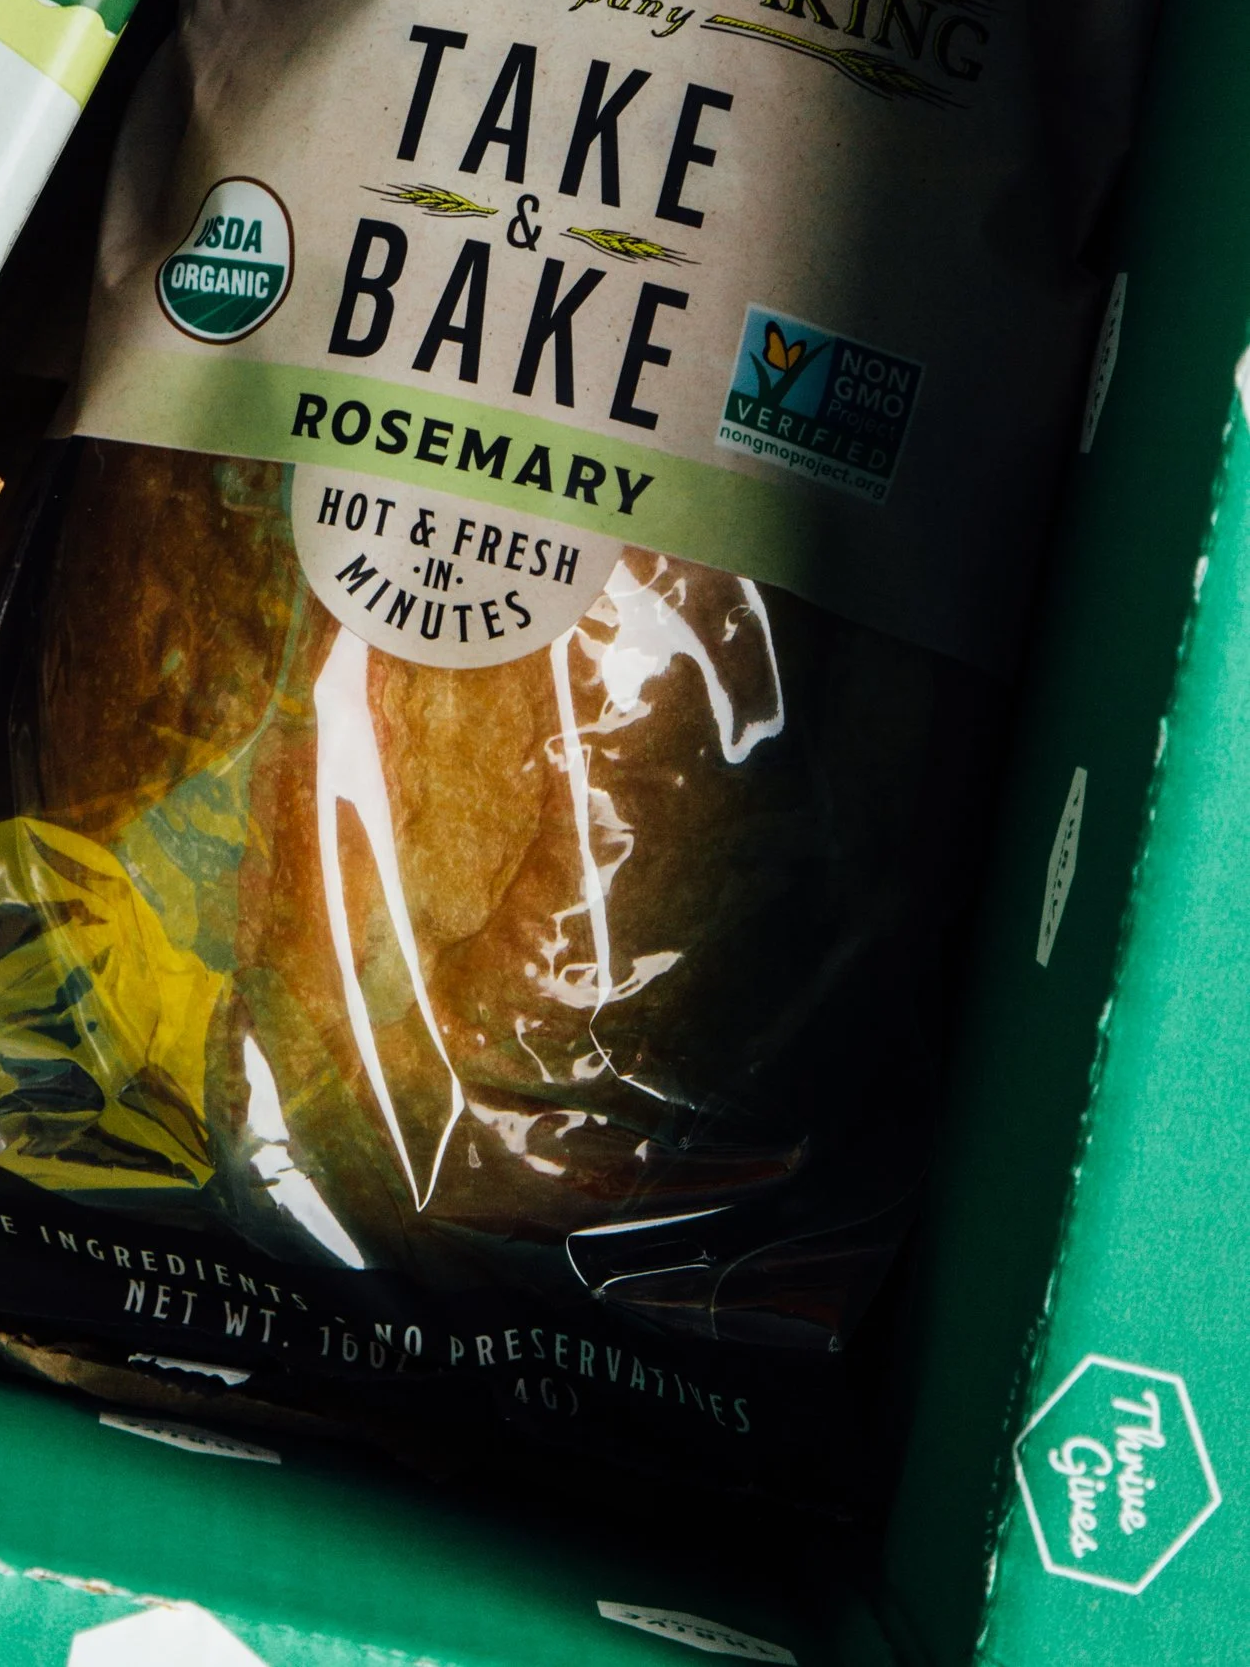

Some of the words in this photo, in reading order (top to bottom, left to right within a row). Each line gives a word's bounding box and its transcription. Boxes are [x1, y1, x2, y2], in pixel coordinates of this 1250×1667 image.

[395, 24, 734, 230] TAKE
[193, 214, 261, 253] USDA
[507, 192, 545, 251] &
[172, 264, 269, 298] ORGANIC
[327, 217, 690, 431] BAKE
[832, 374, 905, 419] GMO
[839, 349, 910, 392] NON
[291, 391, 656, 517] ROSEMARY
[719, 425, 885, 499] nongmoproject.org
[734, 400, 887, 470] VERIFIED
[317, 487, 396, 536] HOT
[410, 507, 435, 547] &
[455, 517, 582, 585] FRESH
[335, 553, 532, 644] MINUTES
[40, 1224, 309, 1314] INGREDIENTS
[374, 1323, 421, 1358] NO
[450, 1325, 750, 1433] PRESERVATIVES
[1050, 1437, 1112, 1558] Gives
[1111, 1391, 1166, 1534] Thrive
